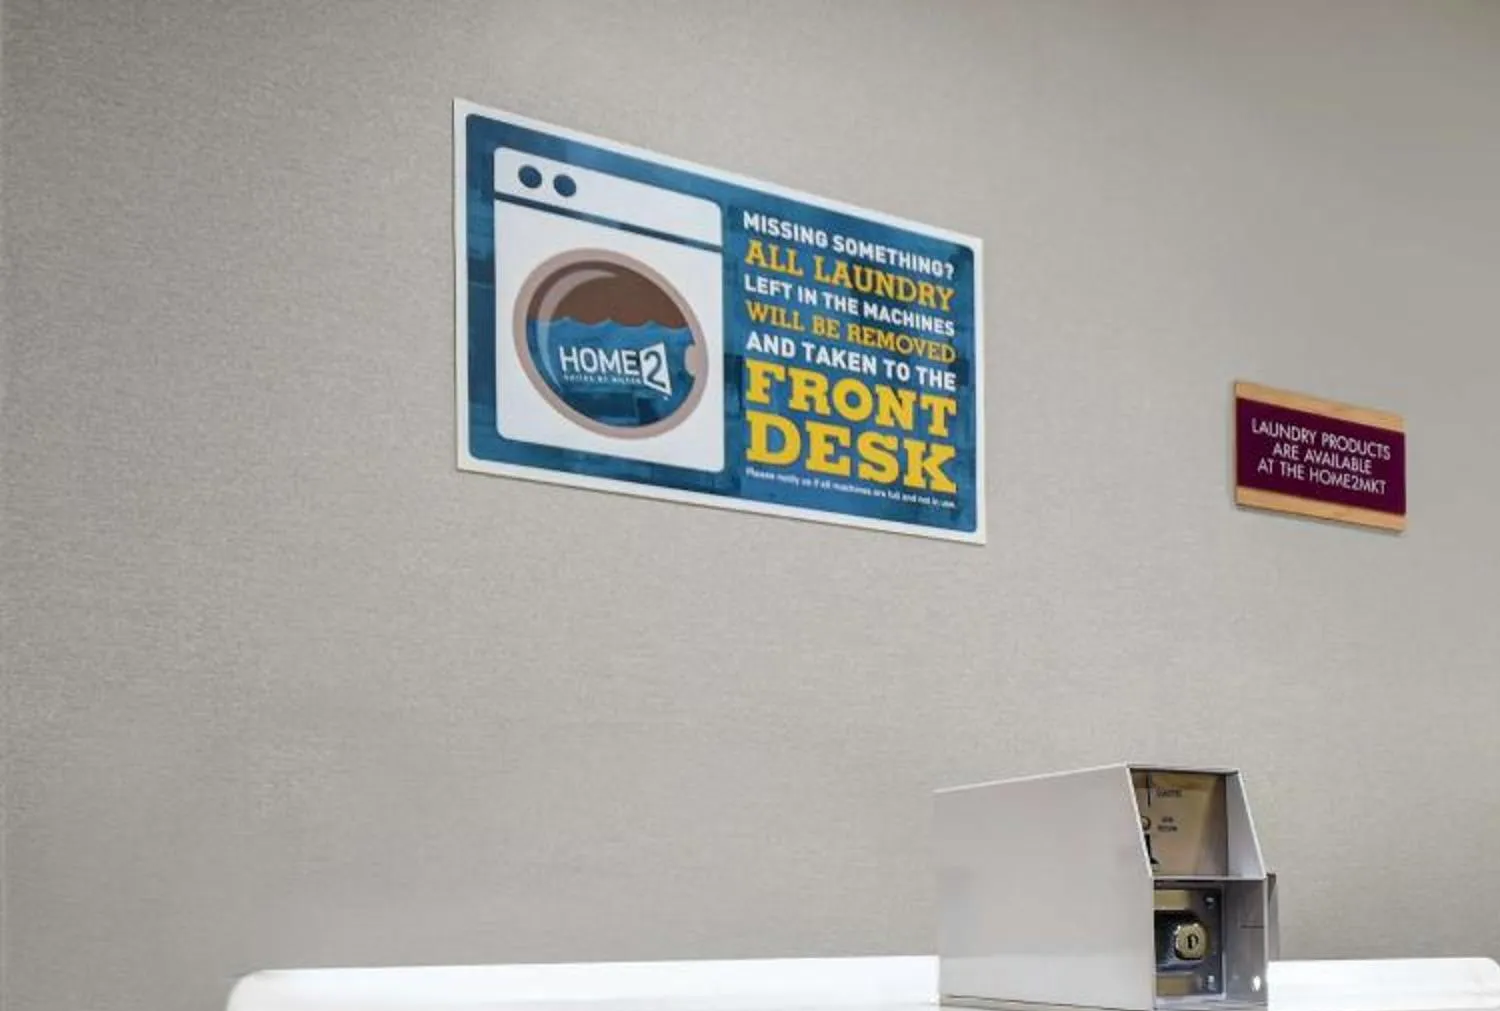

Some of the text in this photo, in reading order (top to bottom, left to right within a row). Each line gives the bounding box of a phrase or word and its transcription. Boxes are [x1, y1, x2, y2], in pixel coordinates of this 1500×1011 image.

[743, 211, 954, 280] MISSING SOMETHING?
[745, 239, 955, 311] ALL LAUNDRY
[743, 274, 955, 337] LEFT IN THE MACHINES
[745, 300, 956, 364] WILL BE REMOVED
[746, 331, 956, 391] AND TAKEN TO THE
[745, 359, 957, 437] FRONT
[745, 410, 957, 494] DESK
[1251, 418, 1391, 461] LAUNDRY PRODUCTS
[1273, 442, 1373, 475] ARE AVAILABLE
[1257, 458, 1386, 495] AT THE HOME2MKT
